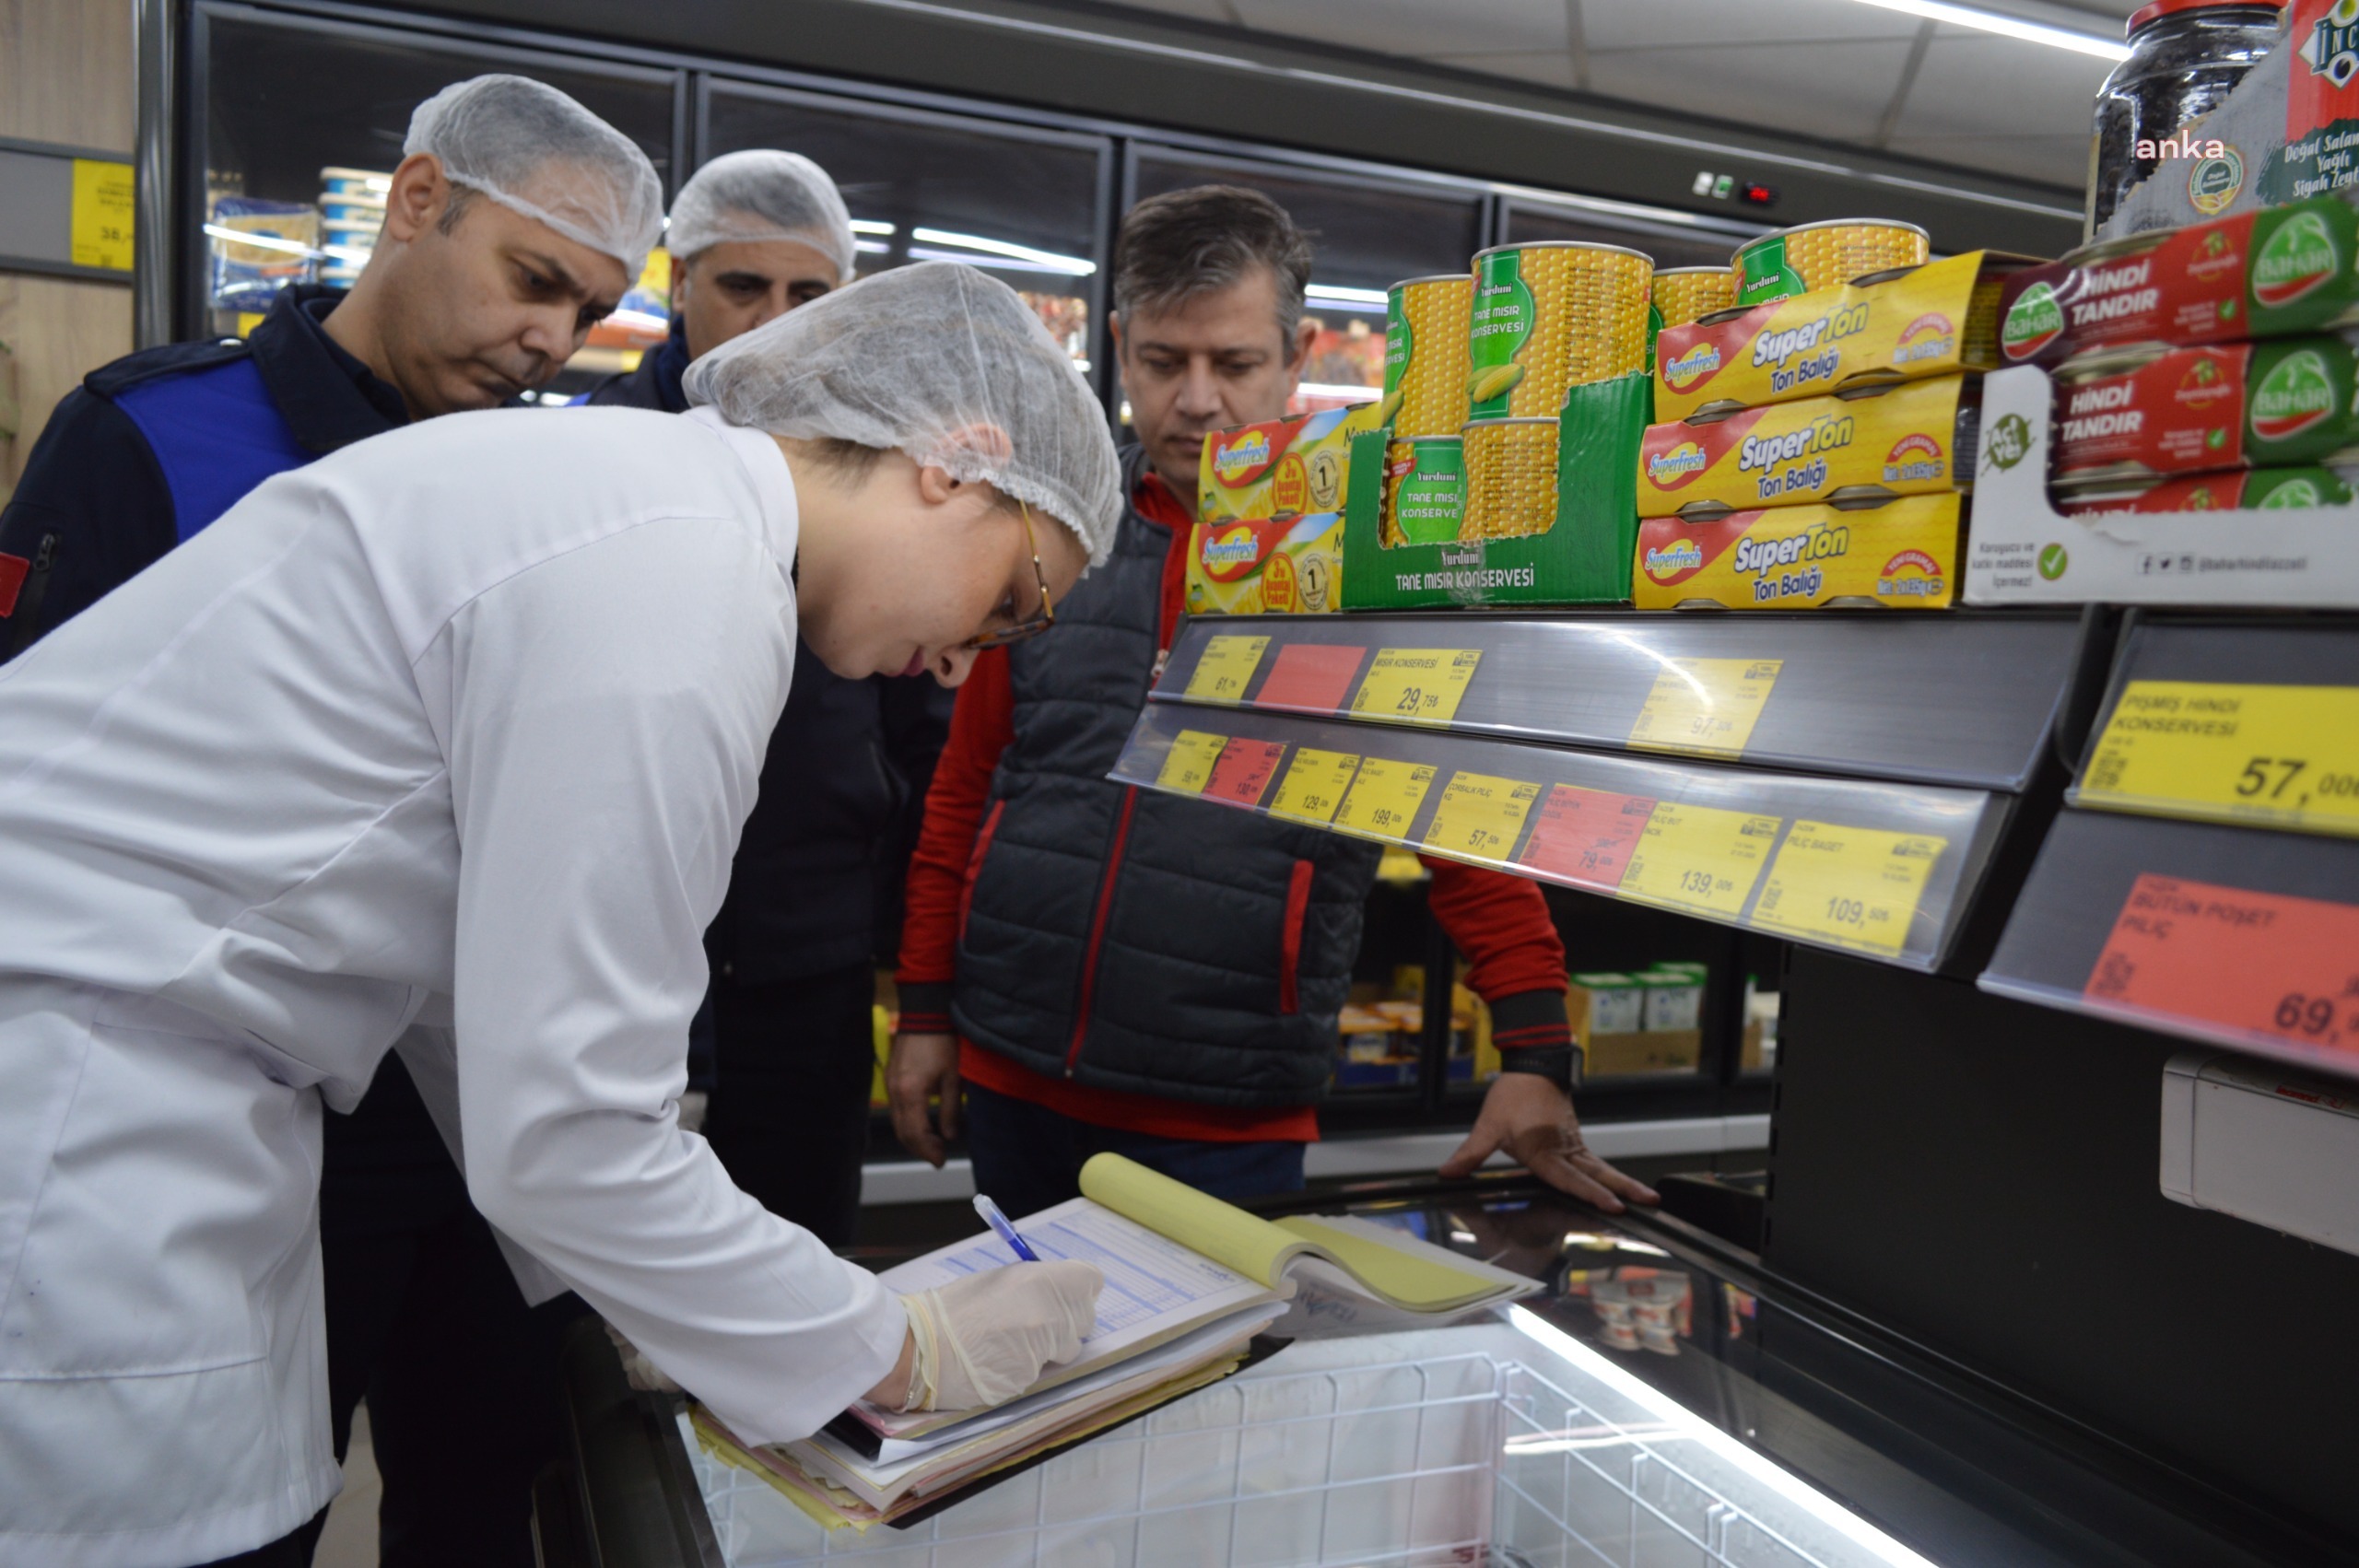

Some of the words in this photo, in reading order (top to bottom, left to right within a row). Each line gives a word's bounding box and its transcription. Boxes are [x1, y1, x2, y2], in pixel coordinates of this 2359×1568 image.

[2284, 137, 2319, 164] Doğal
[2317, 152, 2350, 174] Yağlı
[2293, 174, 2329, 199] Siyah
[2084, 259, 2151, 297] HİNDİ
[1492, 305, 1520, 318] MISIR
[2071, 288, 2159, 326] TANDIR
[1471, 318, 1524, 339] KONSERVESİ
[1665, 346, 1719, 382] SuperFresh
[1770, 370, 1795, 394] Ton
[1798, 346, 1841, 387] Balığı
[2071, 380, 2134, 415] HİNDİ
[2061, 411, 2143, 443] TANDIR
[1215, 437, 1270, 473] SuperFresh
[1648, 447, 1706, 478] SuperFresh
[1319, 465, 1326, 486] 1
[1417, 472, 1457, 482] Yurdum
[1757, 476, 1782, 499] Ton
[1785, 458, 1827, 492] Balığı
[1407, 493, 1432, 502] TANE
[1402, 508, 1457, 519] KONSERVE
[1203, 533, 1259, 568] SuperFresh
[1441, 549, 1479, 567] Yurdum
[1645, 543, 1703, 573] SuperFresh
[1308, 568, 1316, 590] 1
[1395, 574, 1422, 591] TANE
[1424, 572, 1453, 590] MISIR
[1456, 561, 1534, 589] KONSERVESİ
[1753, 579, 1778, 602] Ton
[1780, 566, 1823, 598] Balığı
